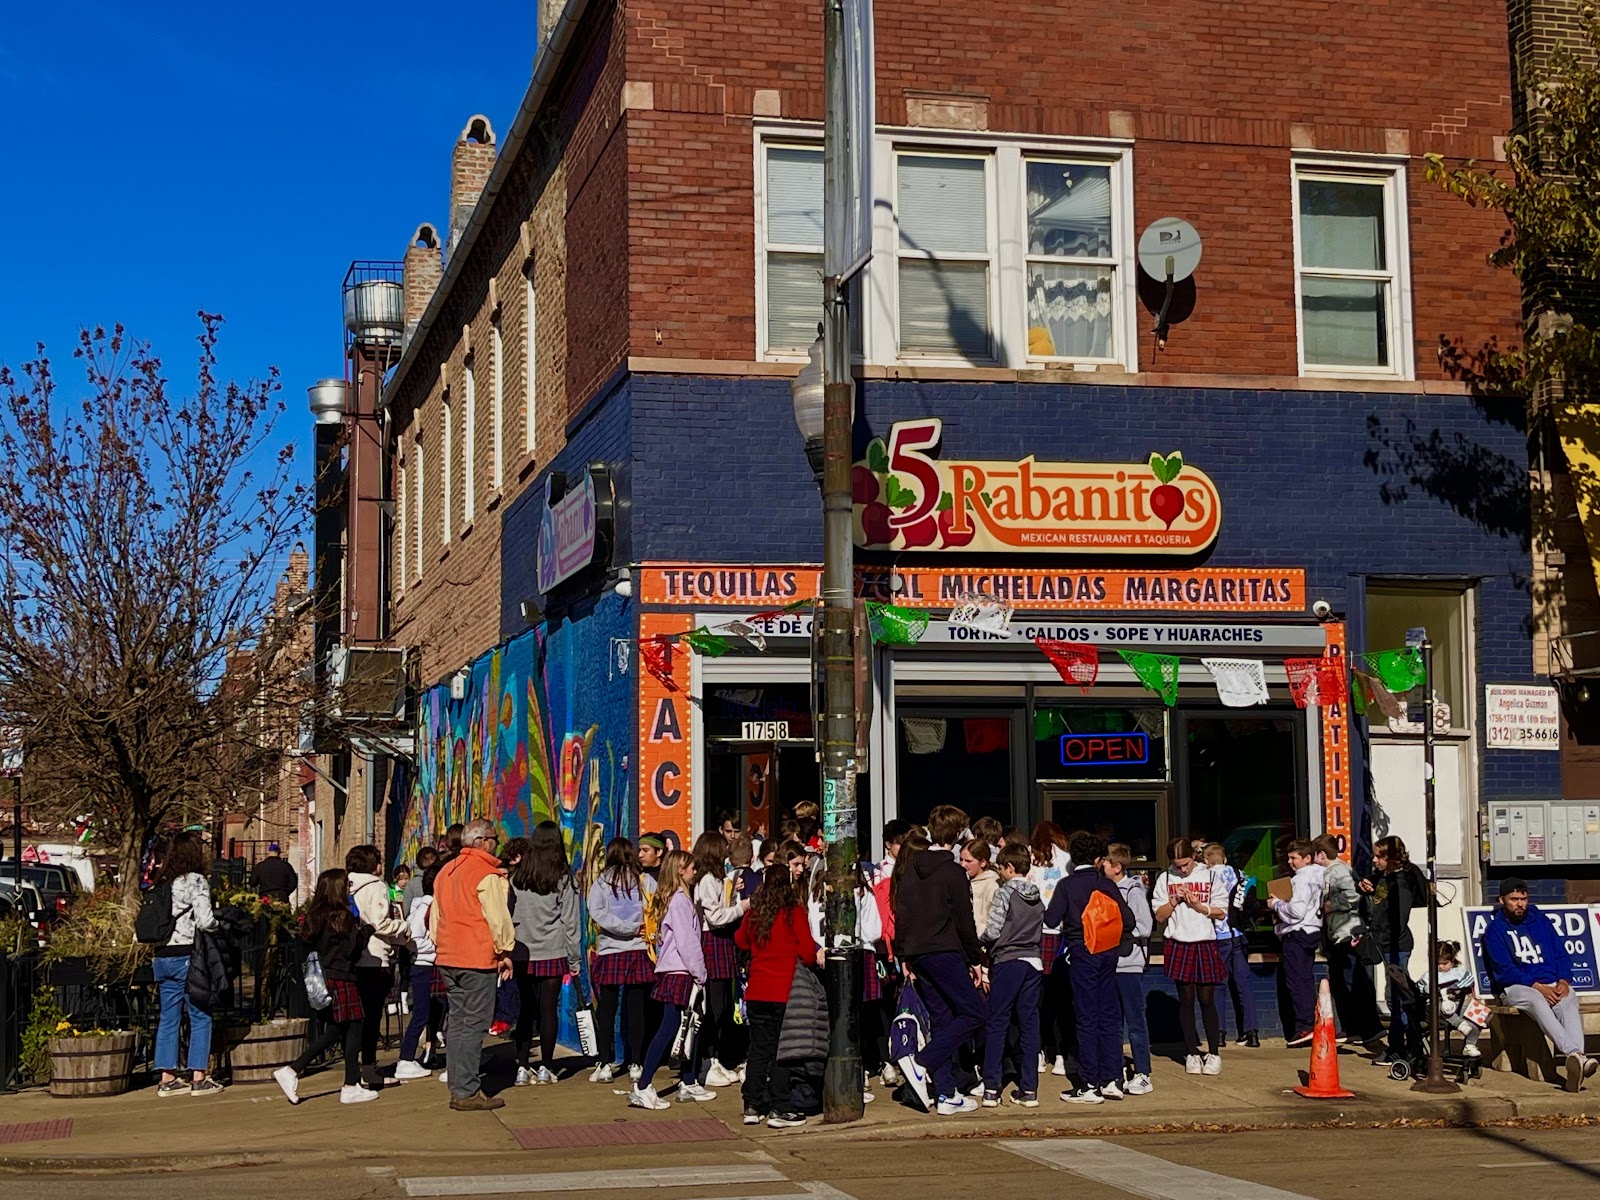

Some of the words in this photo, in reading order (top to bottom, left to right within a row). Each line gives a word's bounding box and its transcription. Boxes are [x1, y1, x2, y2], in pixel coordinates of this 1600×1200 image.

[888, 421, 942, 528] 5
[1020, 533, 1066, 543] MEXICAN
[1069, 534, 1132, 544] RESTAURANT
[1134, 534, 1141, 543] &
[1143, 534, 1191, 545] TAQUERIA
[664, 570, 797, 598] TEQUILAS
[940, 575, 1106, 601] MICHELADAS
[1124, 577, 1293, 603] MARGARITAS
[779, 620, 802, 634] DE
[948, 626, 1010, 640] TORTA
[1025, 627, 1090, 641] CALDOS
[1106, 627, 1149, 641] SOPE
[1153, 628, 1164, 641] Y
[1167, 628, 1263, 642] HUARACHES
[1518, 689, 1547, 697] MANAGED
[1499, 698, 1524, 710] Angelica
[1525, 698, 1548, 709] Guzman
[1539, 715, 1557, 725] Street
[744, 723, 788, 740] 1758
[1489, 726, 1512, 745] (312)
[1066, 738, 1143, 760] OPEN
